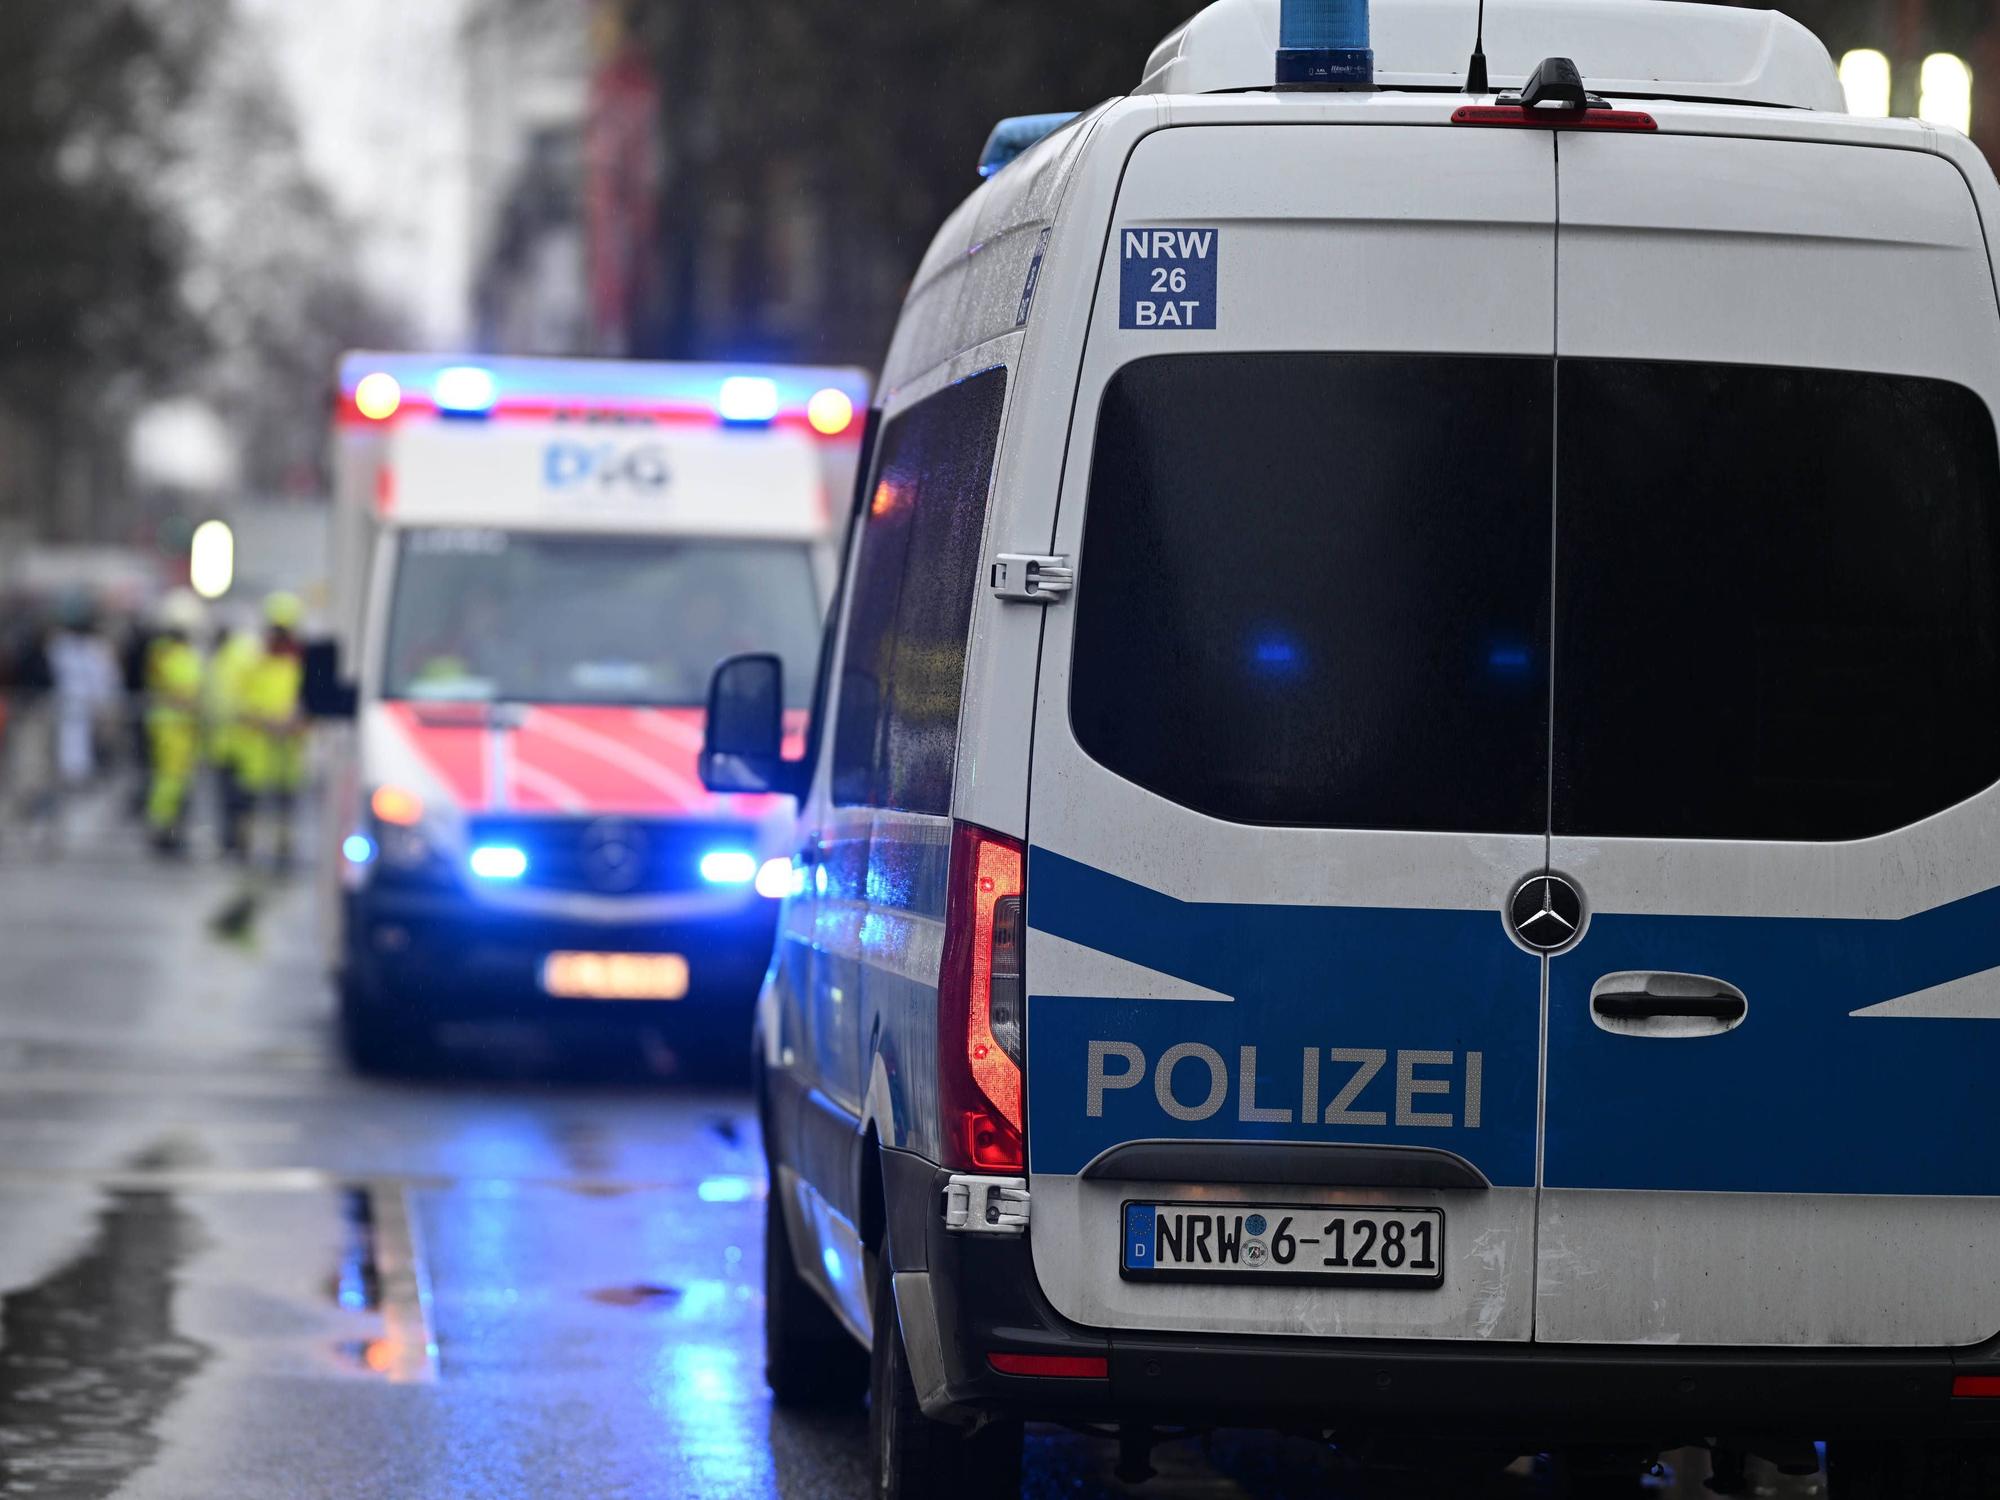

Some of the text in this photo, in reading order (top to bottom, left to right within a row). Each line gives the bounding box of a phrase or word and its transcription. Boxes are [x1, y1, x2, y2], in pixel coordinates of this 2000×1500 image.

[1125, 231, 1212, 259] NRW
[1150, 267, 1187, 293] 26
[1136, 300, 1200, 326] BAT
[1086, 1040, 1483, 1128] POLIZEI
[1135, 1243, 1146, 1257] D
[1155, 1213, 1436, 1269] NRW 6-1281
